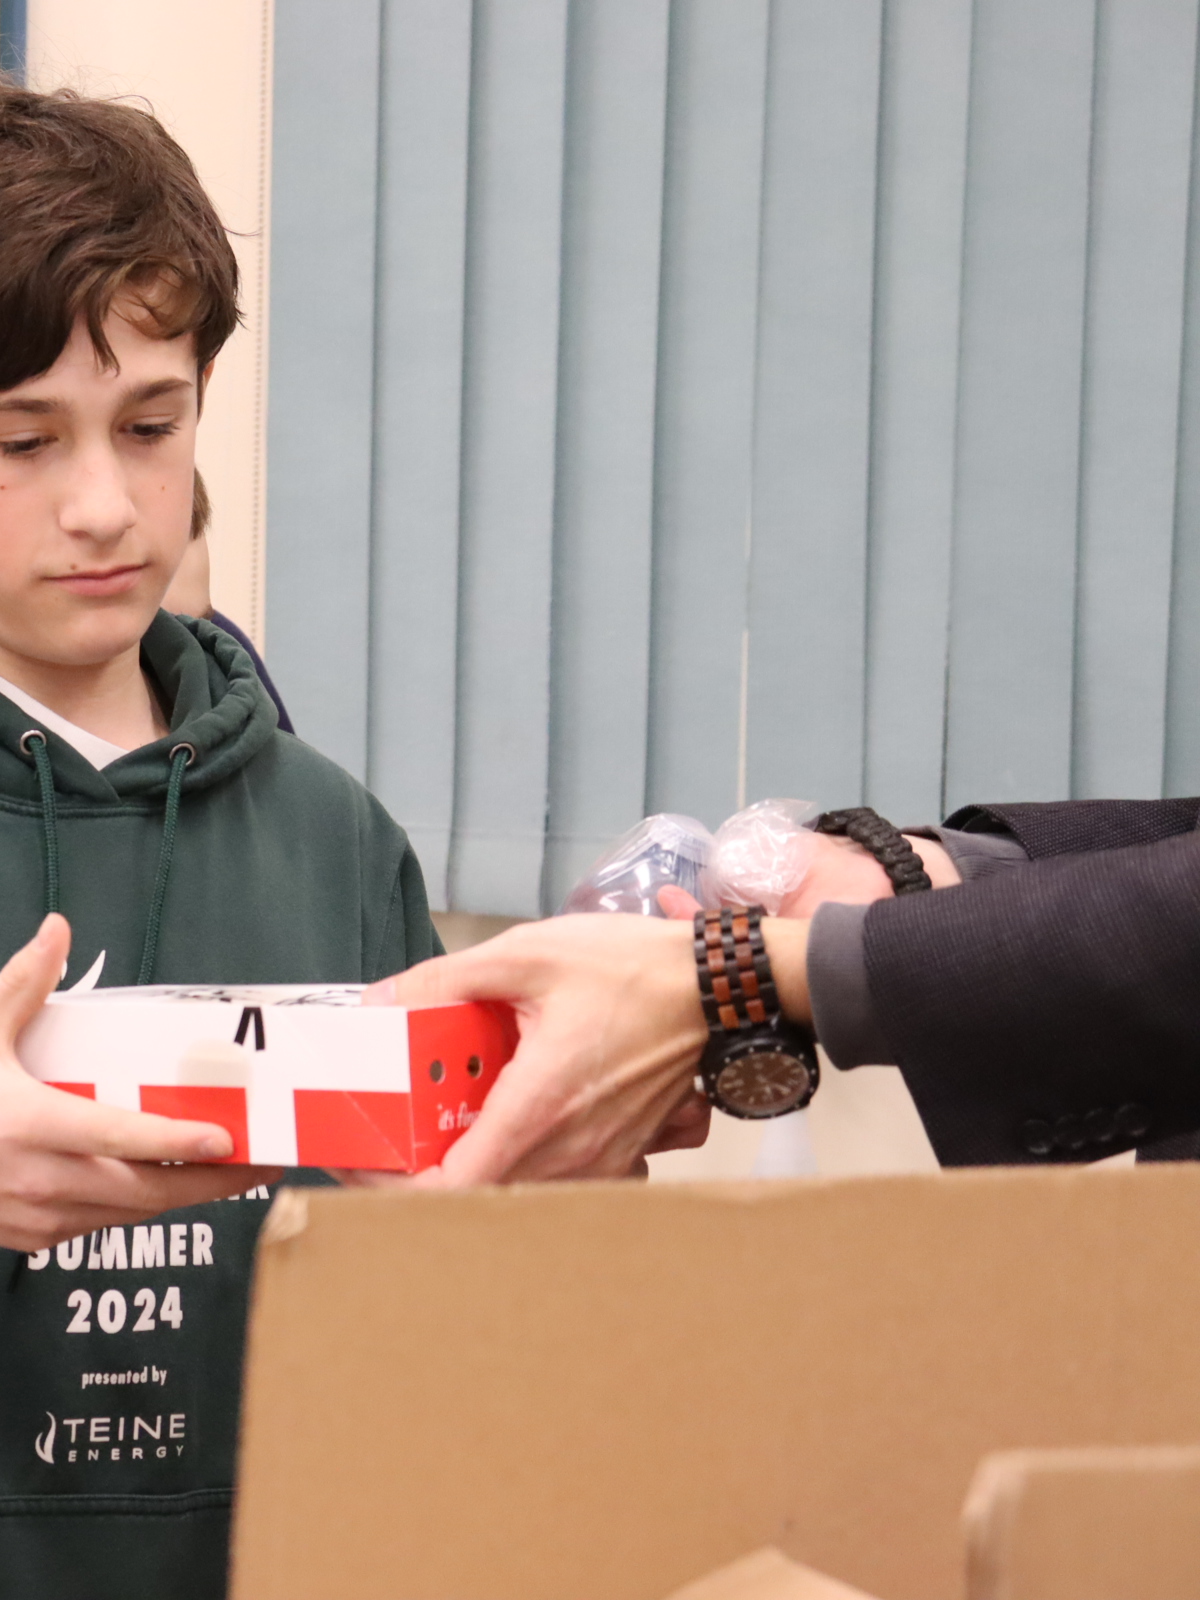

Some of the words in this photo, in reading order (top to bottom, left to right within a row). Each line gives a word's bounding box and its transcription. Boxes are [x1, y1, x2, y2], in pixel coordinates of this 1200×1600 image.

[65, 1286, 184, 1334] 2024
[81, 1366, 148, 1389] presented
[151, 1365, 167, 1386] by
[62, 1413, 186, 1443] TEINE
[67, 1445, 184, 1462] ENERGY
